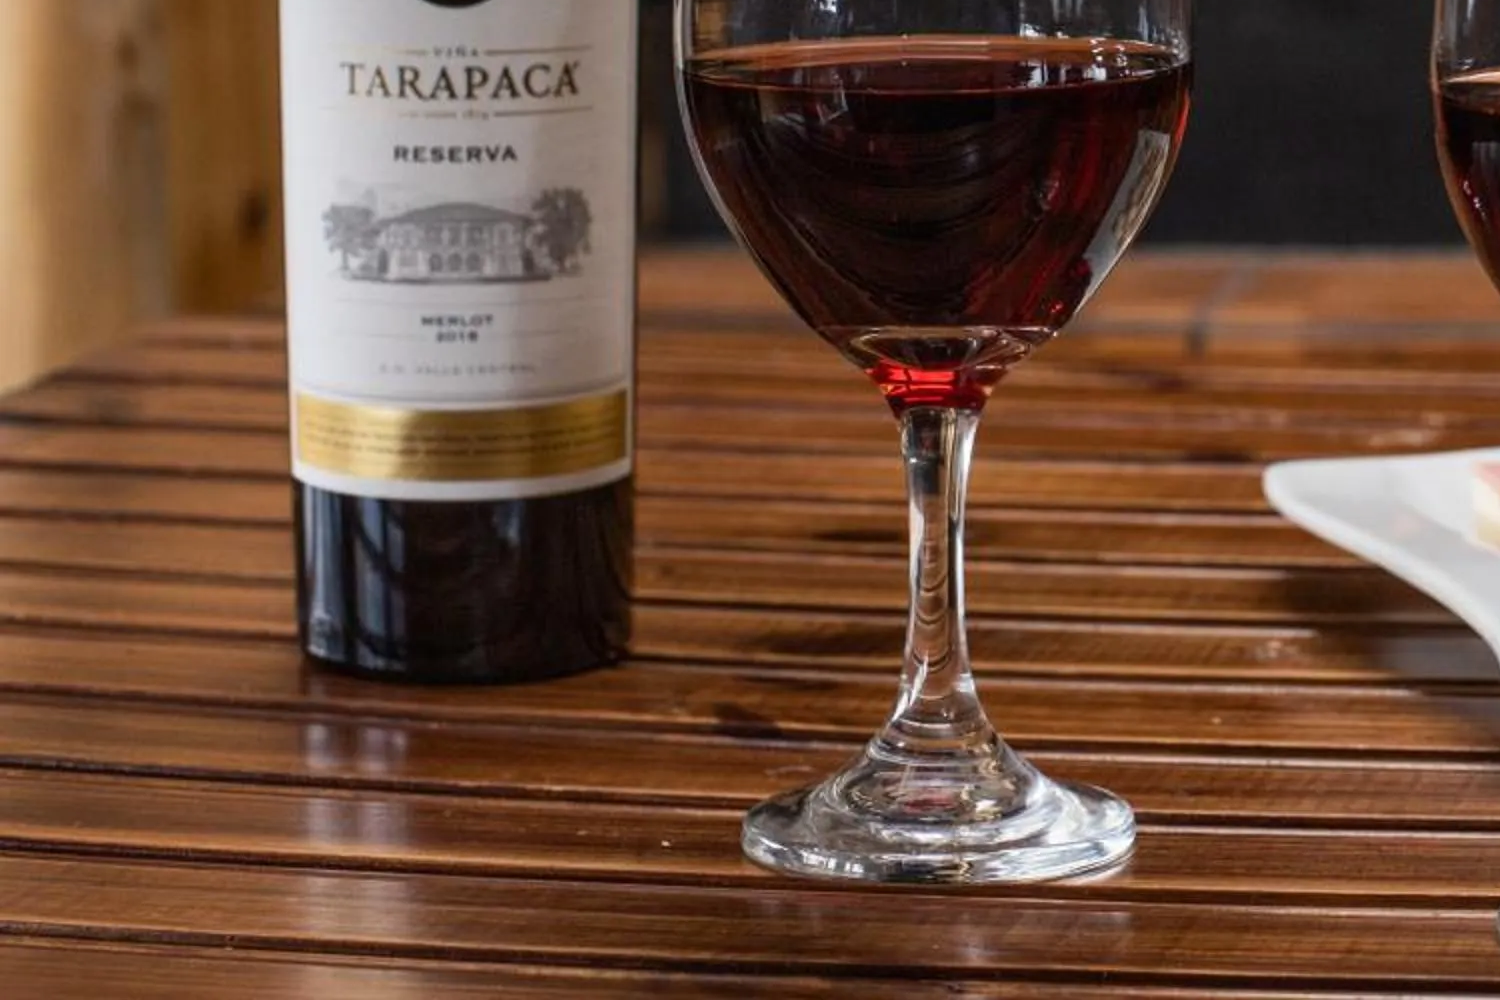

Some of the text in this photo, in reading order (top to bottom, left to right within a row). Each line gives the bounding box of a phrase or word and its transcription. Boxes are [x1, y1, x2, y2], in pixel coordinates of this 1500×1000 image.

[340, 60, 581, 101] TARAPACÁ
[393, 145, 518, 163] RESERVA
[420, 314, 494, 327] MERLOT
